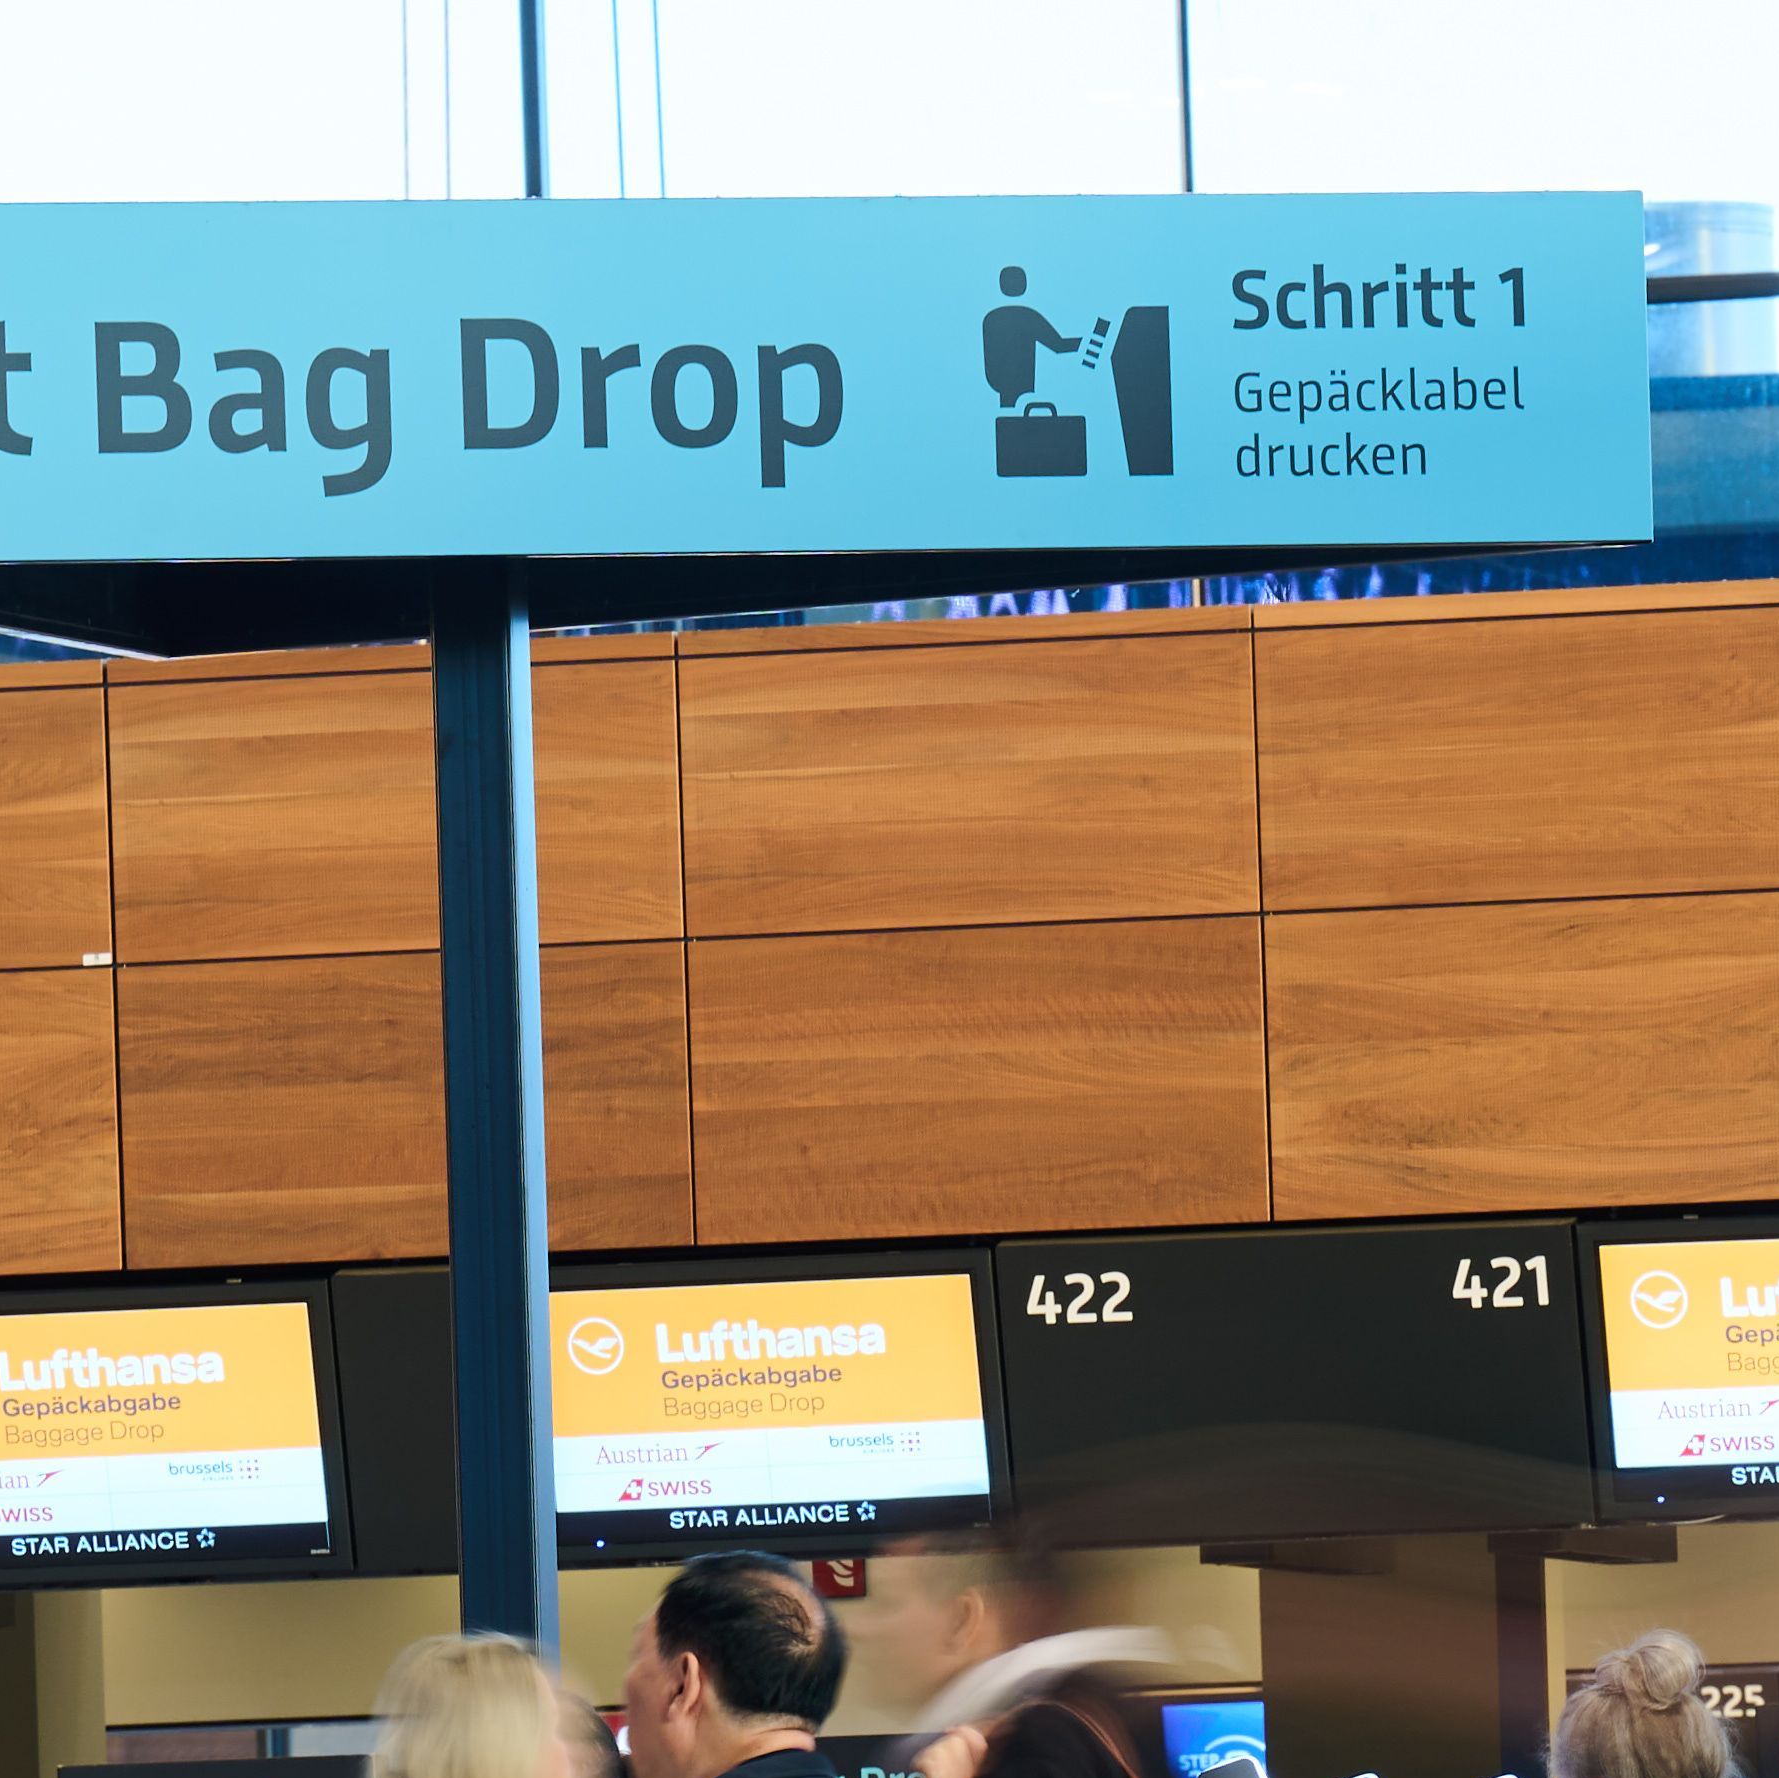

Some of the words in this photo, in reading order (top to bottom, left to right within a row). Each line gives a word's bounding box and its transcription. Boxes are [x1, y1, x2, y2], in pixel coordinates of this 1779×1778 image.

[1227, 258, 1480, 340] Schritt
[1494, 262, 1530, 332] 1
[90, 315, 397, 500] Bag
[457, 310, 849, 490] Drop
[1230, 358, 1528, 428] Gepäcklabel
[1230, 425, 1432, 483] drucken
[1024, 1271, 1136, 1326] 422
[1451, 1255, 1551, 1310] 421
[655, 1317, 886, 1364] Lufthansa
[660, 1364, 844, 1393] Gepäckabgabe
[0, 1390, 183, 1426] Gepäckabgabe
[662, 1392, 765, 1421] Baggage
[769, 1390, 827, 1416] Drop
[1655, 1394, 1755, 1424] Austrian
[2, 1418, 103, 1449] Baggage
[106, 1416, 167, 1447] Drop
[827, 1430, 895, 1451] brussels
[1708, 1432, 1777, 1455] SWISS
[166, 1457, 235, 1481] brussels
[595, 1442, 690, 1466] Austrian
[647, 1478, 713, 1499] SWISS
[669, 1508, 730, 1530] STAR
[734, 1502, 851, 1527] ALLIANCE
[9, 1530, 74, 1558] STAR
[77, 1527, 192, 1555] ALLIANCE
[1701, 1685, 1765, 1718] 225
